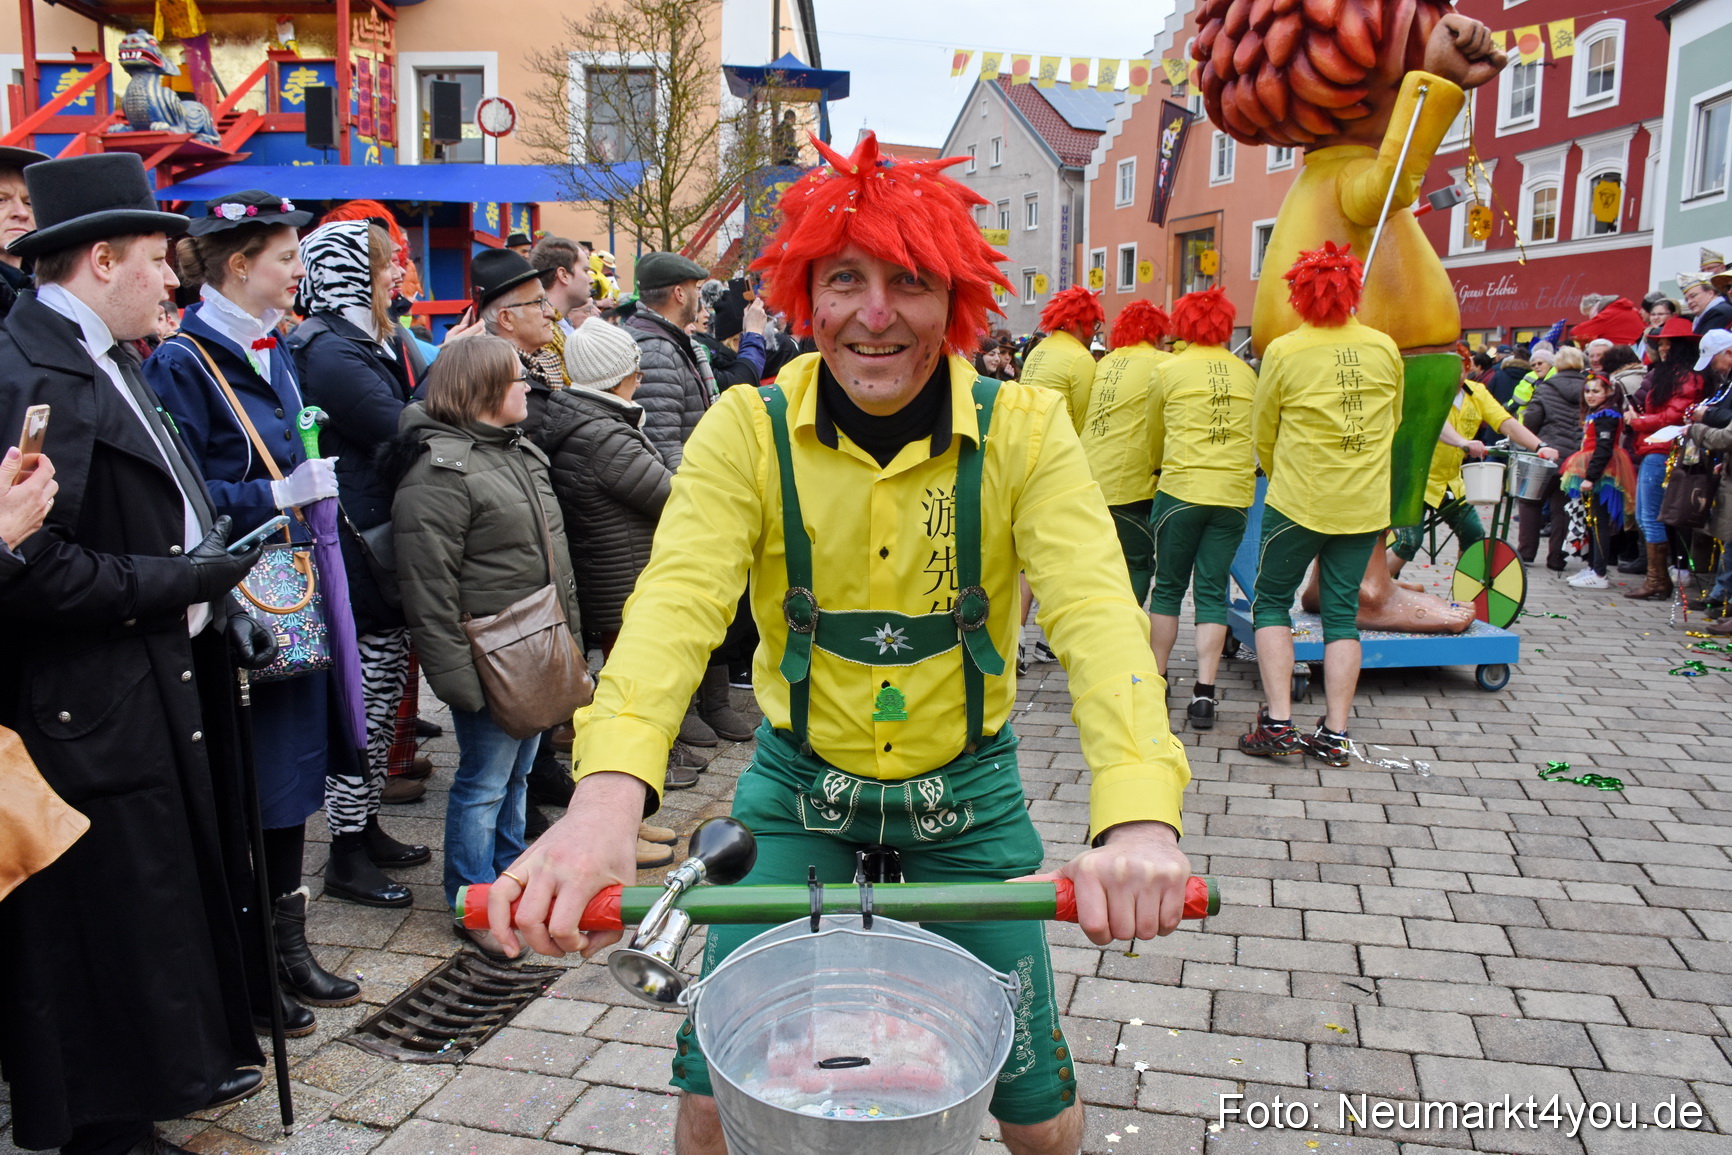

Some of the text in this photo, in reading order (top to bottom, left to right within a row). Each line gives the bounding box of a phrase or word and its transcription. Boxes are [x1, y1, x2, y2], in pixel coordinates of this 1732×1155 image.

[1061, 206, 1069, 251] UHREN
[1485, 274, 1519, 297] Erlebnis
[1535, 272, 1583, 311] Erlebn
[1333, 347, 1366, 453] 迪特福尔特
